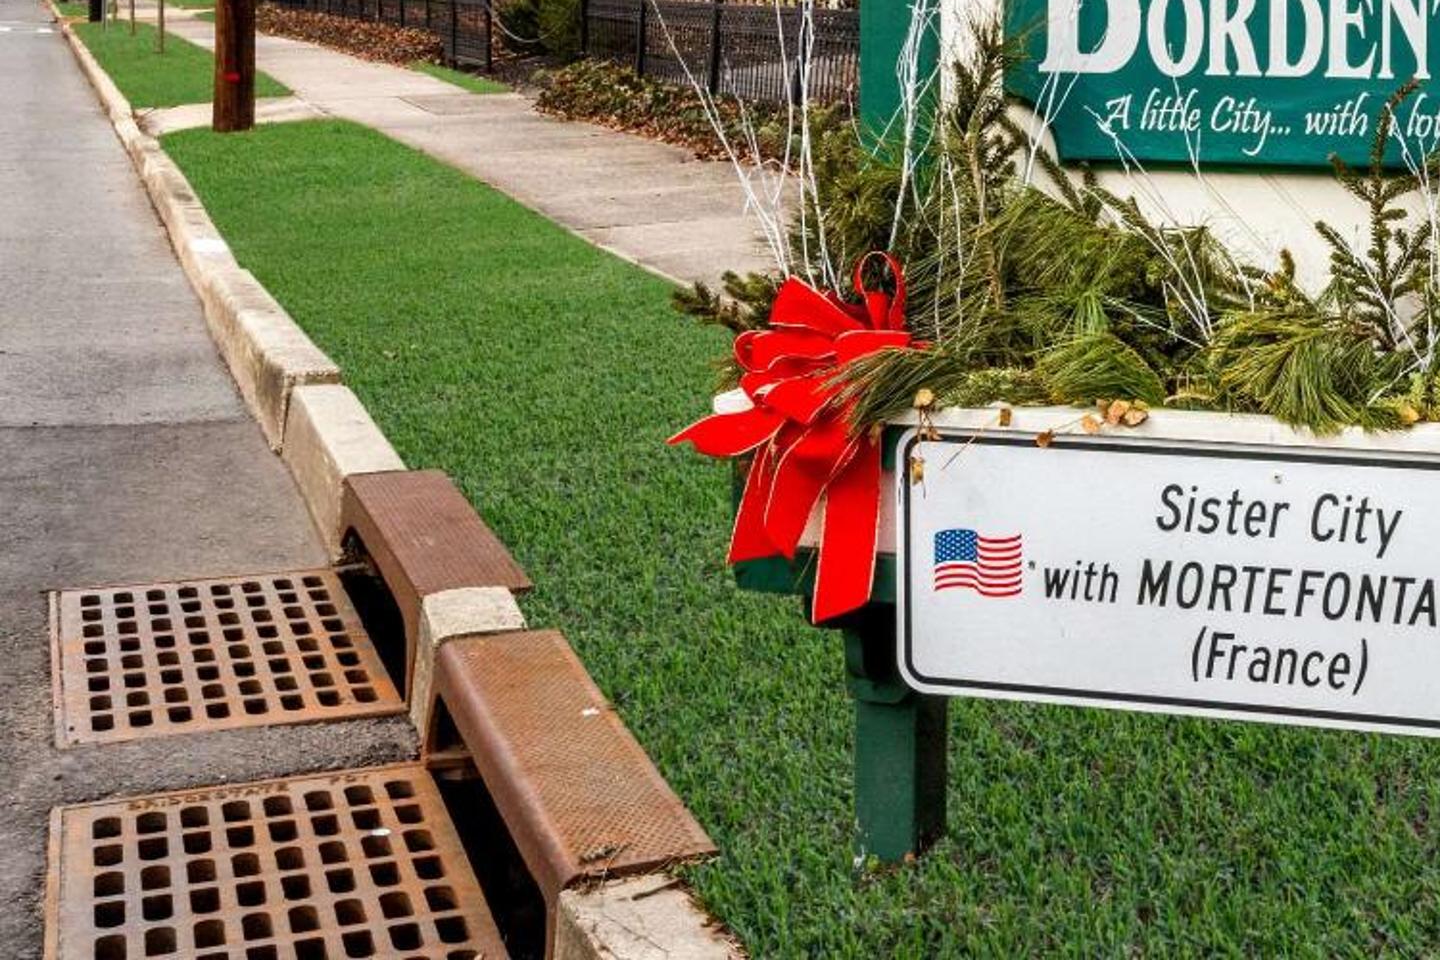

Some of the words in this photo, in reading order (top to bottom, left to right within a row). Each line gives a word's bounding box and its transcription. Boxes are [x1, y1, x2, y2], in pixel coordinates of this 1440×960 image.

[1105, 94, 1132, 130] A
[1140, 87, 1200, 131] little
[1210, 95, 1291, 156] City...
[1305, 92, 1370, 137] with
[1156, 484, 1290, 538] Sister
[1311, 493, 1403, 559] City
[1044, 560, 1119, 603] with
[1191, 625, 1369, 696] (France)
